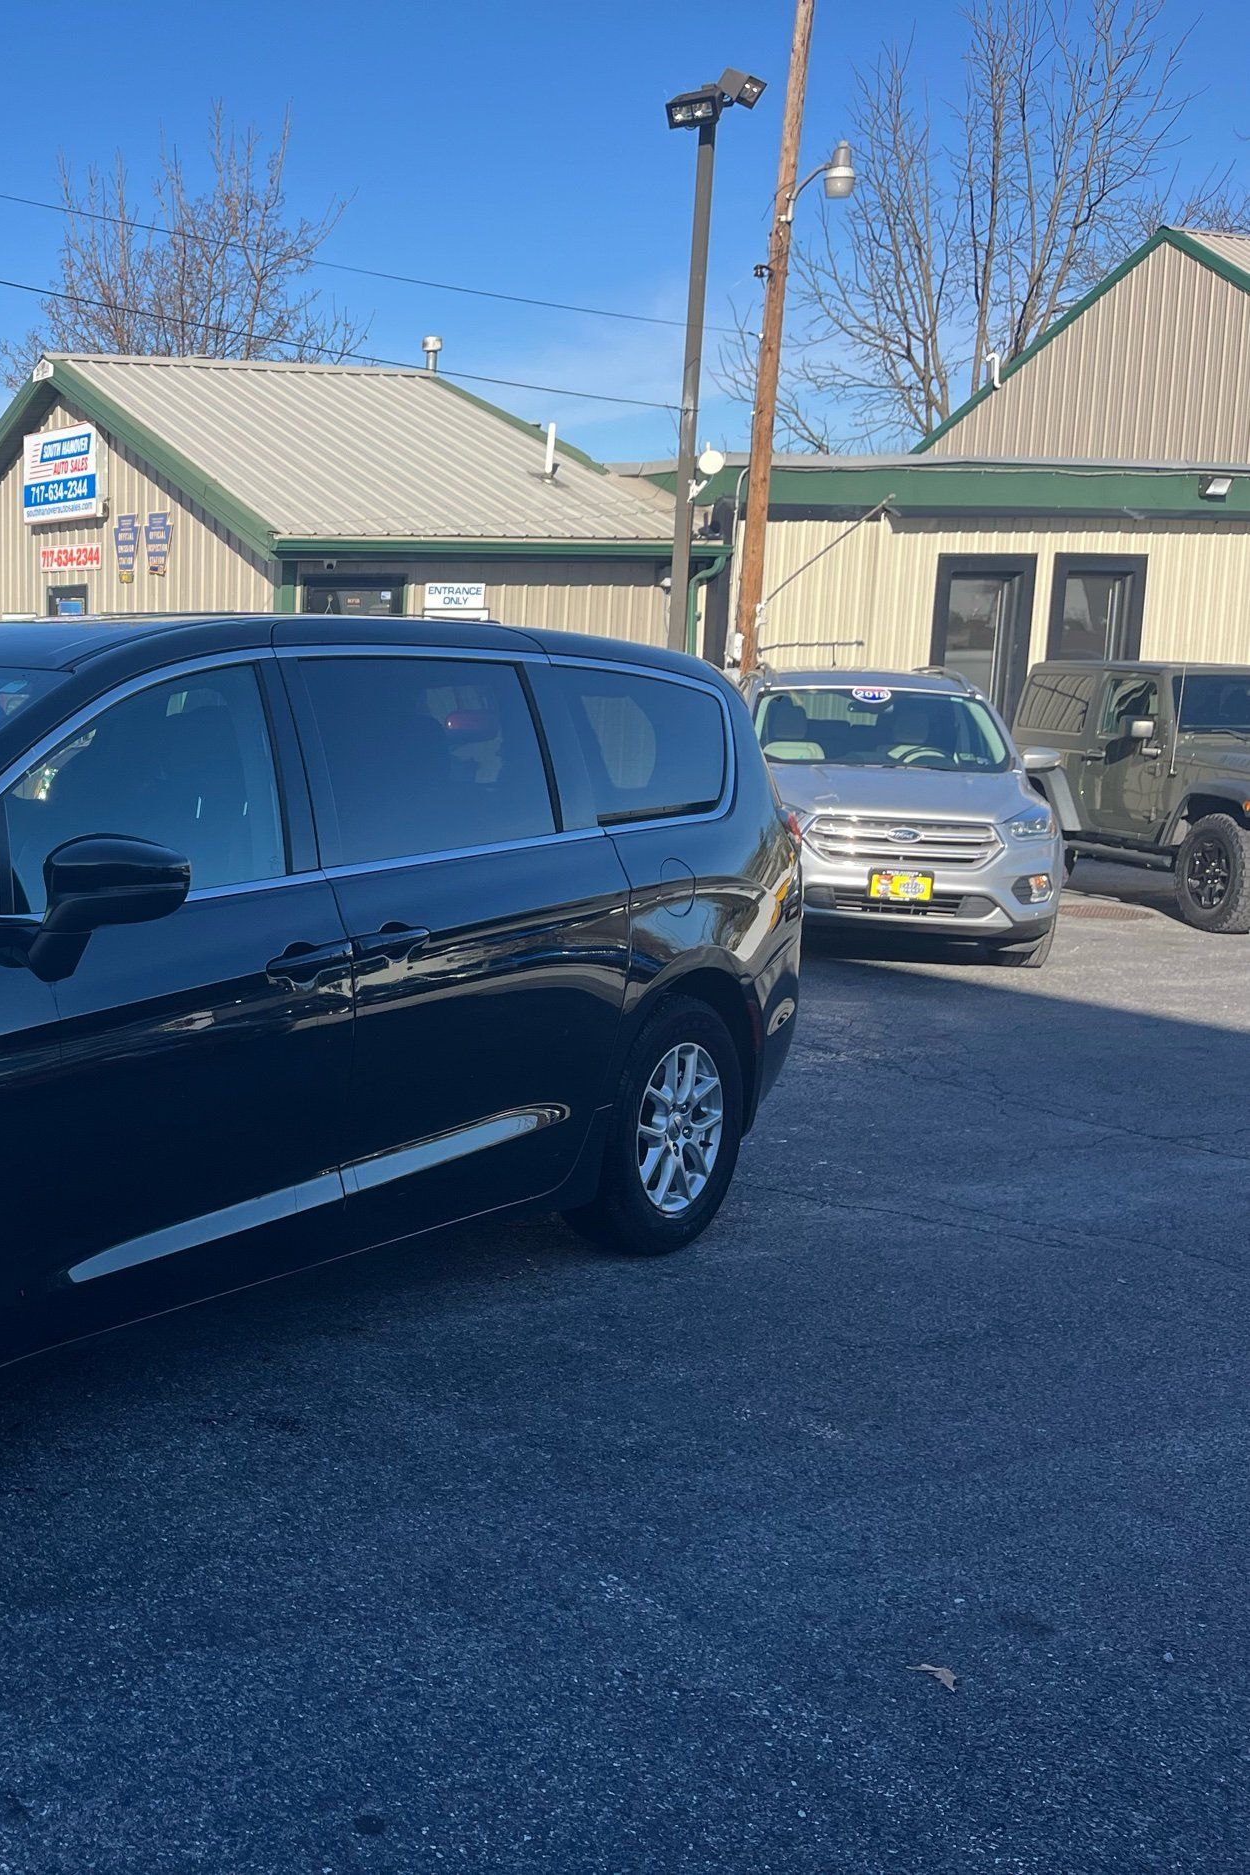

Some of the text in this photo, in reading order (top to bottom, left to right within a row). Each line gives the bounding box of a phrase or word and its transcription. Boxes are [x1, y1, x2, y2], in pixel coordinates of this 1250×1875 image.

[42, 437, 88, 459] SOUTH HANOVER
[53, 457, 88, 475] AUTO SALES
[31, 479, 88, 503] 717-634-2344
[41, 547, 100, 568] 717-634-2344
[428, 586, 482, 596] ENTRANCE
[443, 596, 468, 605] ONLY
